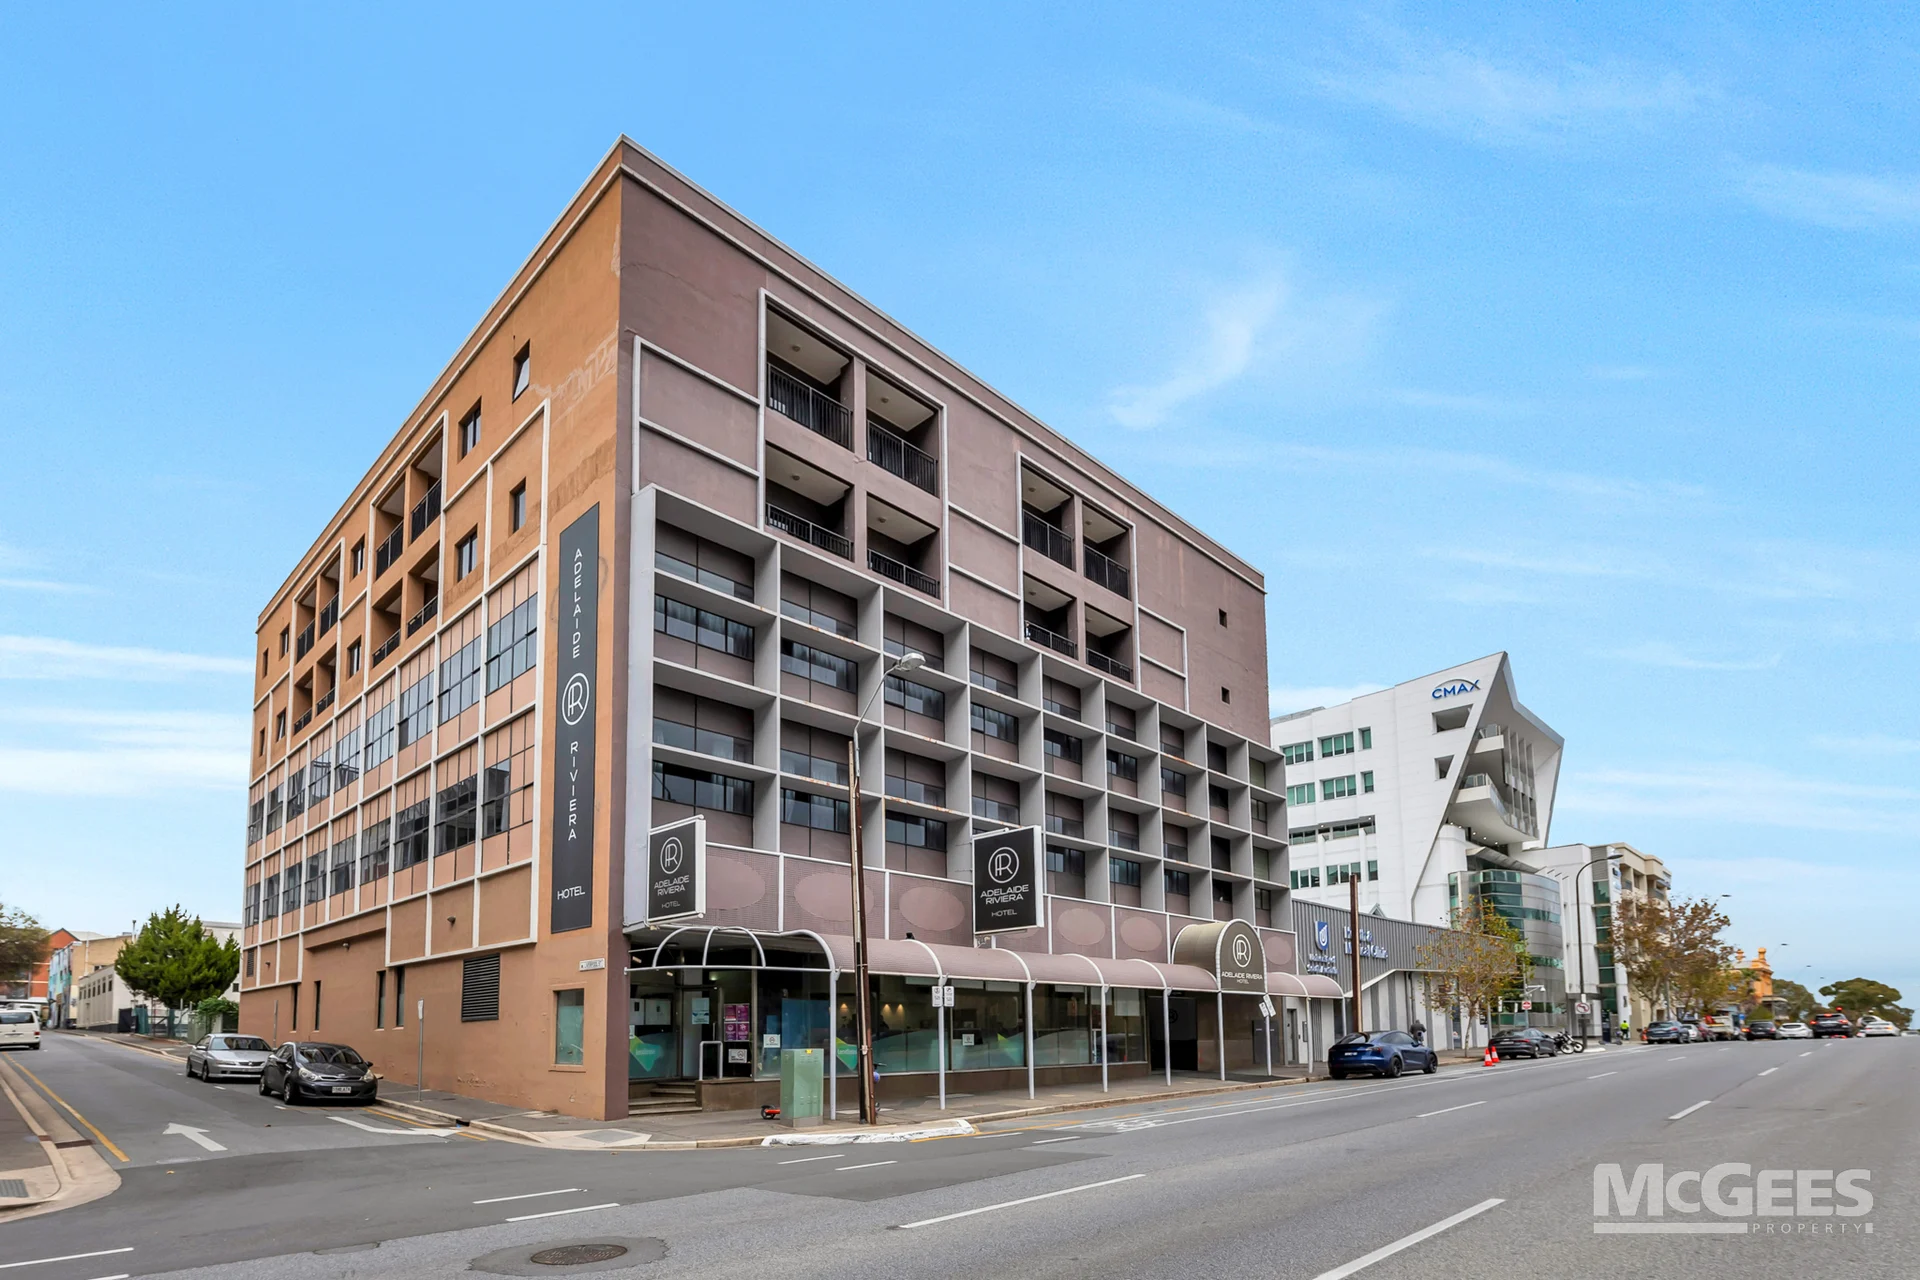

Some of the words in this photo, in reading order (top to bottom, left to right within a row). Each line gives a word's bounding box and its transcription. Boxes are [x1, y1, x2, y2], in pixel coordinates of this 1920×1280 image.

[573, 548, 583, 659] ADELAIDE
[1431, 679, 1481, 699] CMAX
[568, 740, 579, 841] RIVIERA
[654, 875, 690, 890] ADELAIDE
[557, 885, 586, 901] HOTEL
[657, 884, 686, 897] RIVIERA
[980, 884, 1030, 898] ADELAIDE
[661, 900, 681, 909] HOTEL
[985, 893, 1024, 905] RIVIERA
[991, 908, 1018, 917] HOTEL
[1222, 971, 1246, 979] ADELAIDE
[1246, 972, 1263, 980] RIVIERA
